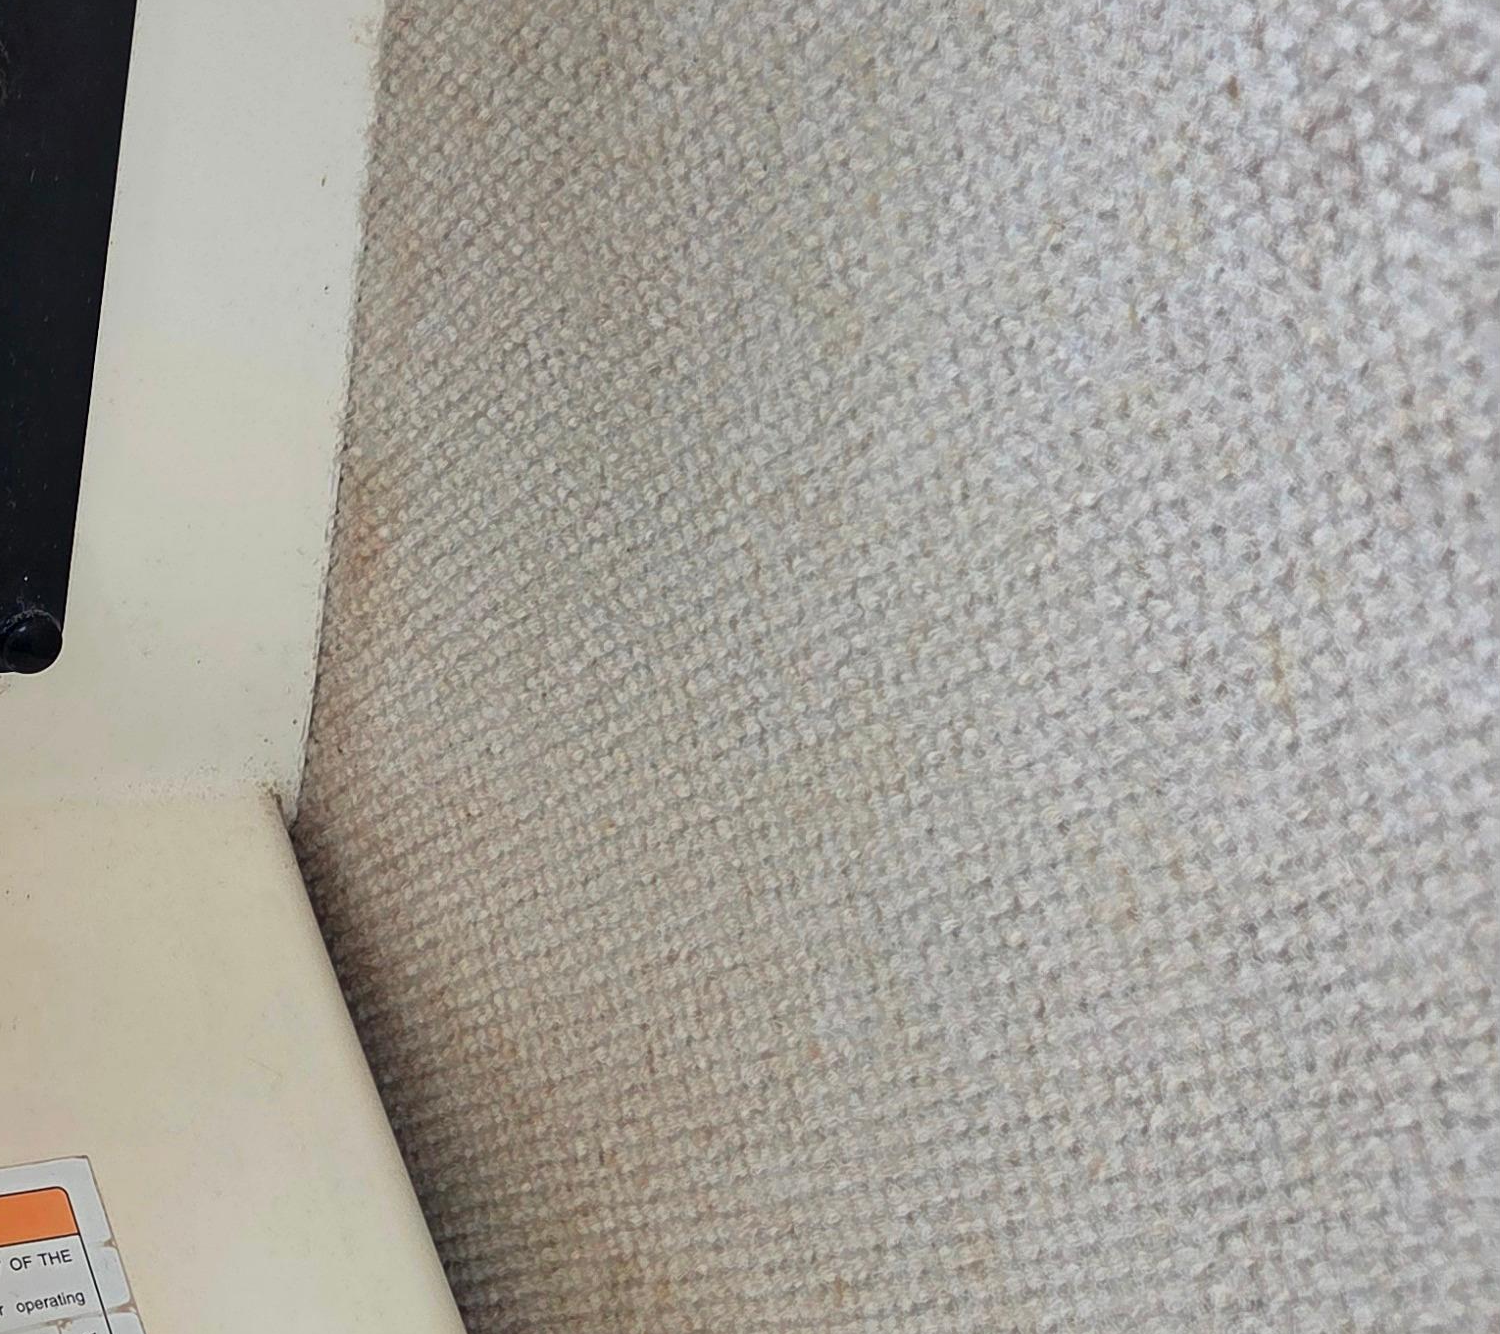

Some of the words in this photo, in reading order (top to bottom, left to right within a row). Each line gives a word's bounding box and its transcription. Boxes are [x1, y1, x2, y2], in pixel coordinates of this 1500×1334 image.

[9, 1255, 33, 1272] OF
[36, 1248, 74, 1267] THE
[15, 1291, 86, 1315] operating
